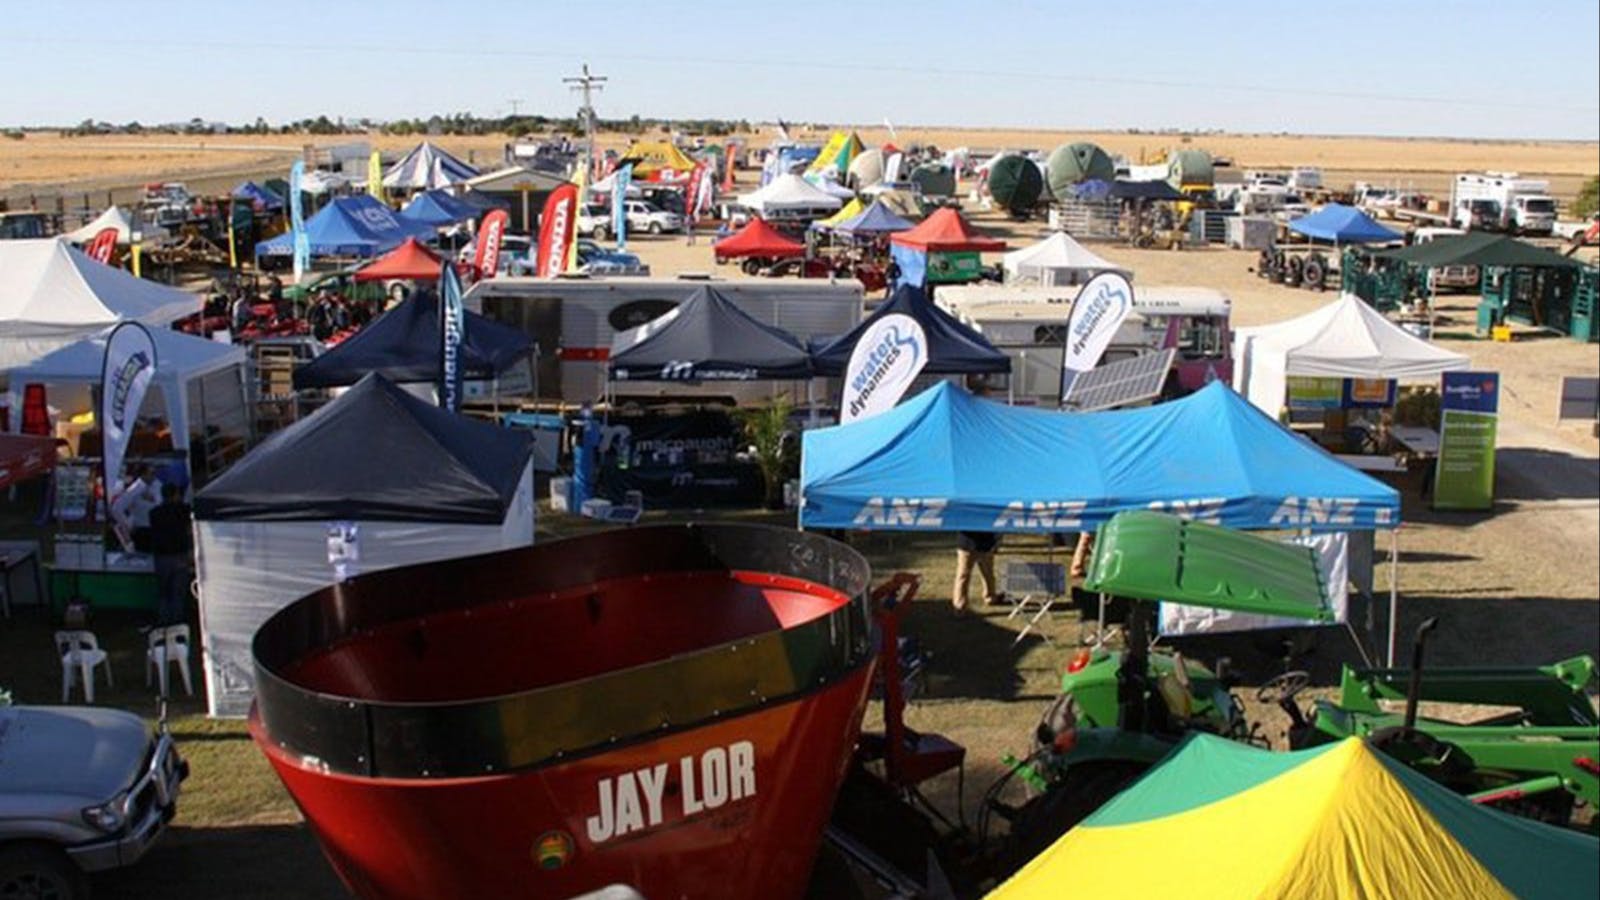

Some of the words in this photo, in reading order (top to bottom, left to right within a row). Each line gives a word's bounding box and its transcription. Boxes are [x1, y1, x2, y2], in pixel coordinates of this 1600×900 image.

[481, 219, 501, 277] ONDA
[1072, 299, 1112, 357] dynamics
[1073, 289, 1106, 336] water
[849, 345, 902, 418] dynamics
[851, 333, 894, 393] water
[853, 497, 949, 526] ANZ
[993, 501, 1088, 528] ANZ
[1269, 497, 1360, 524] ANZ
[586, 763, 669, 843] JAY
[680, 740, 757, 816] LOR
